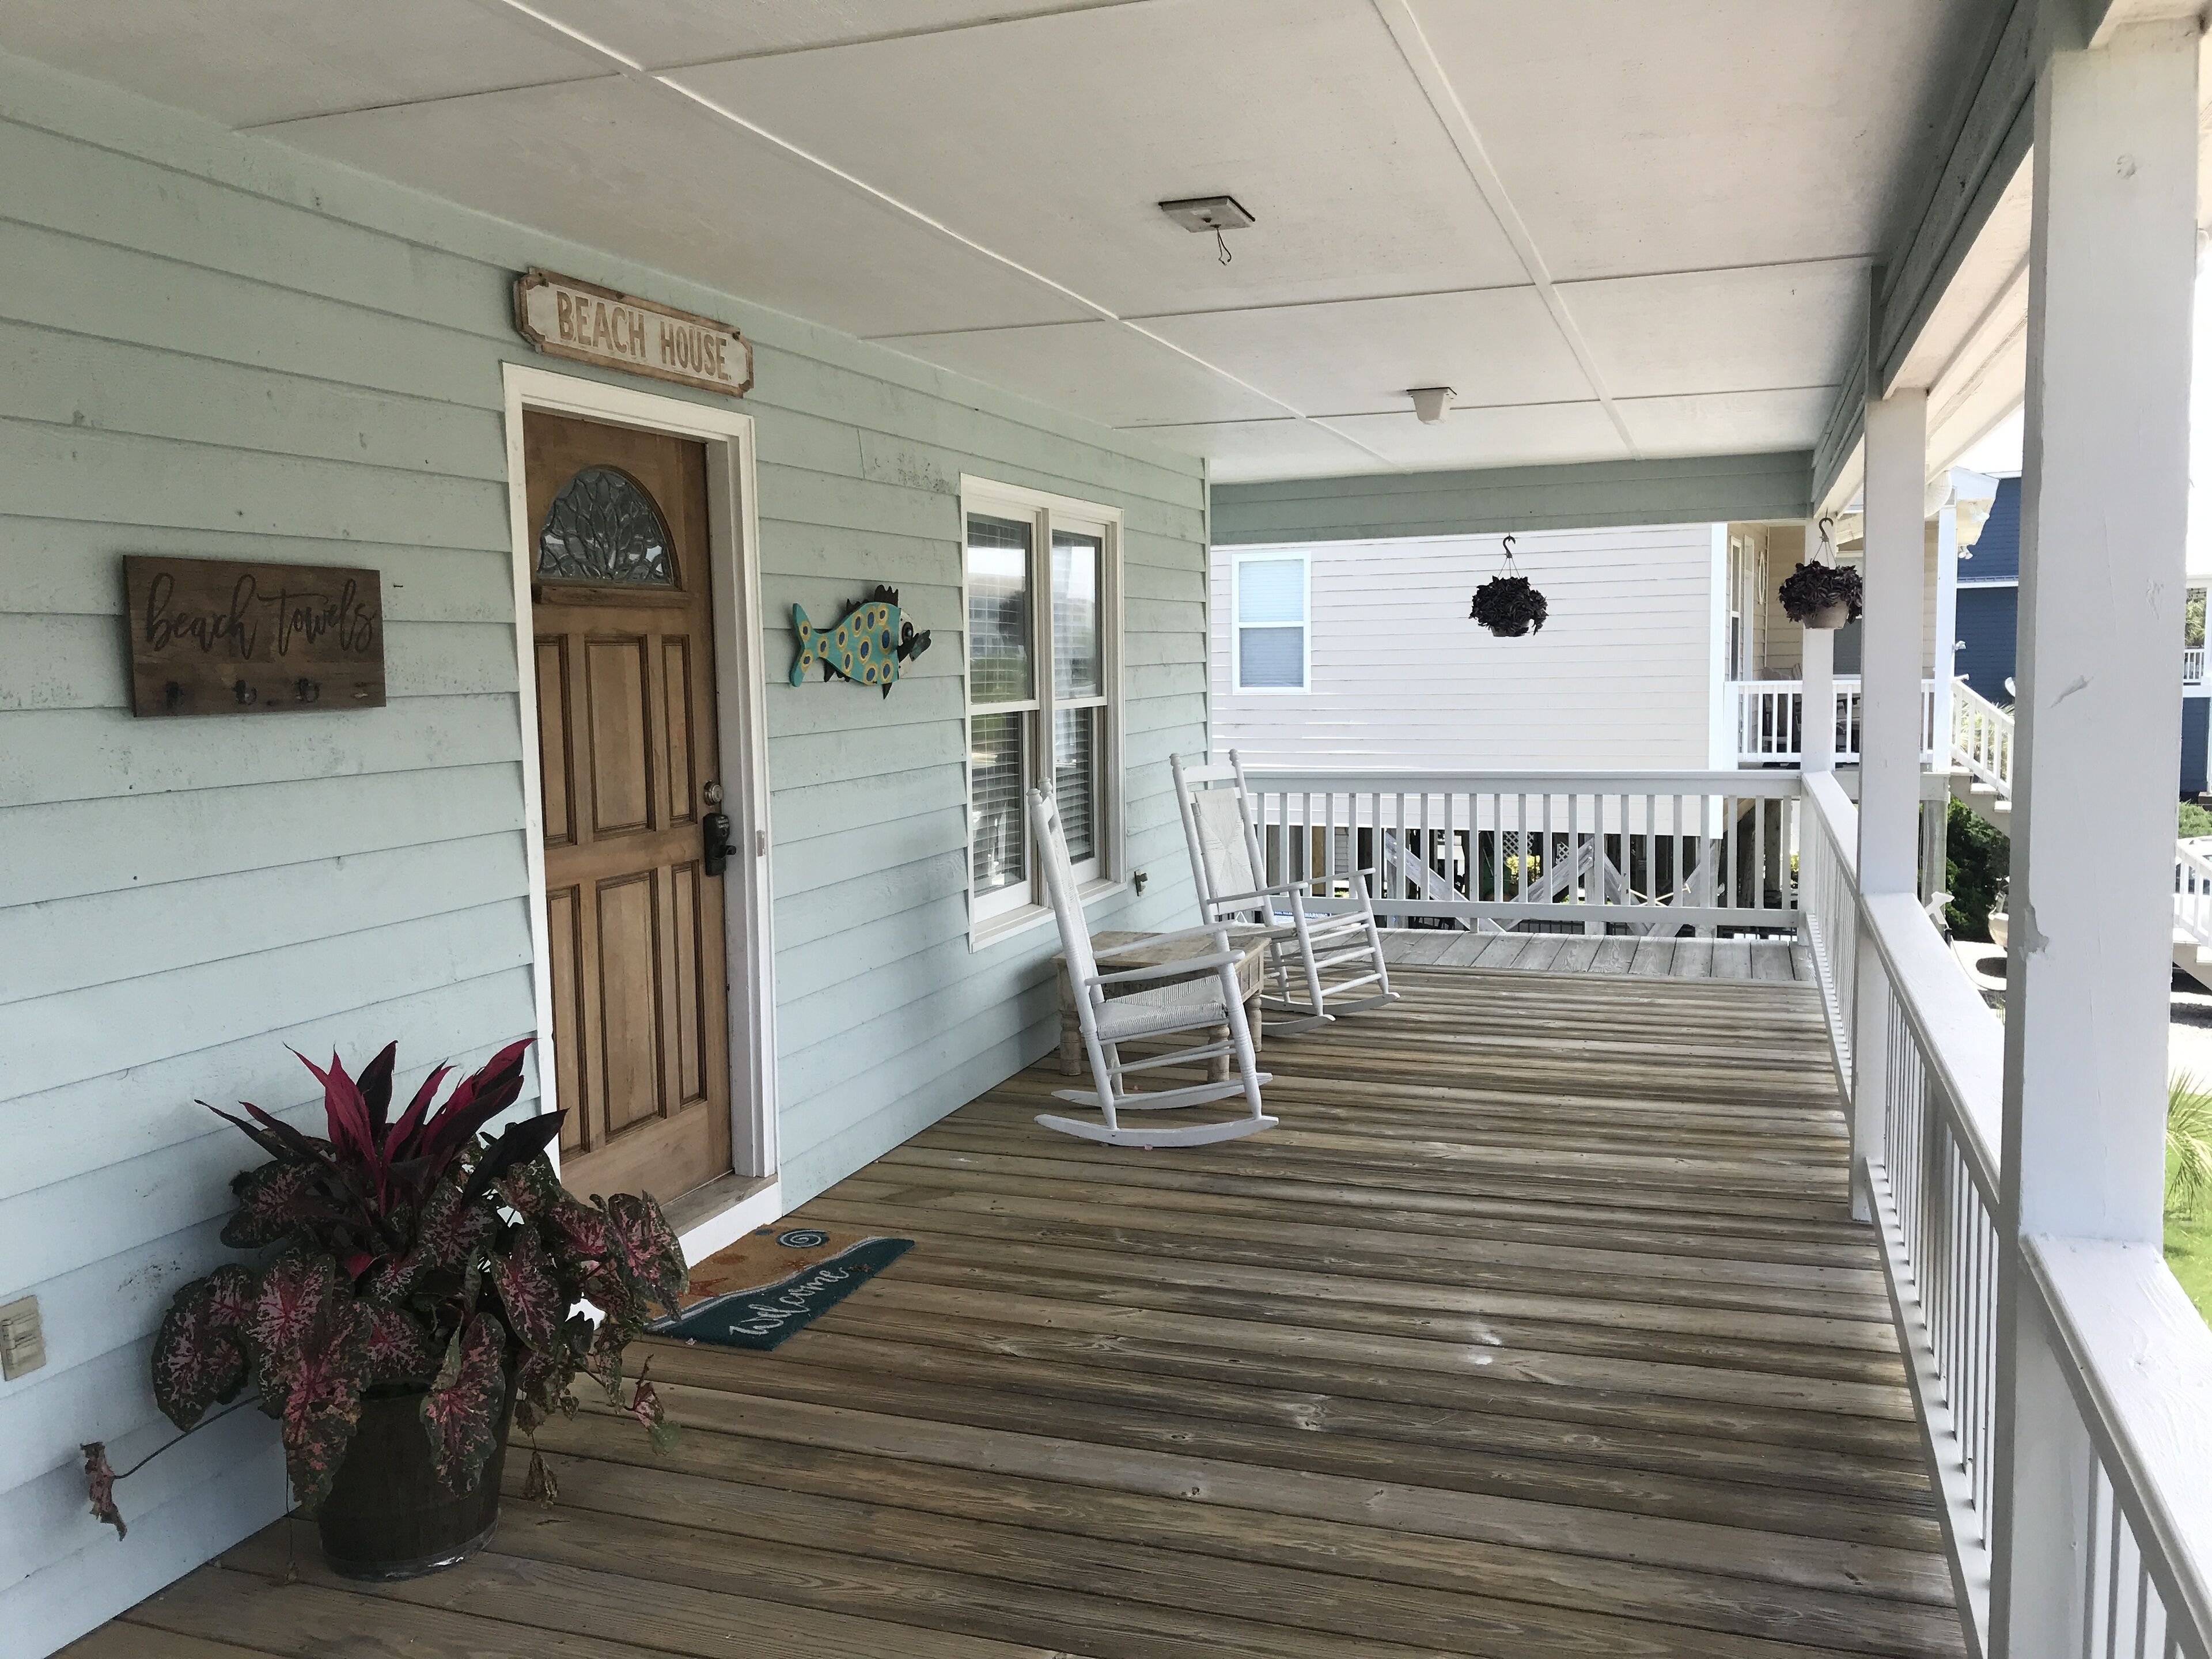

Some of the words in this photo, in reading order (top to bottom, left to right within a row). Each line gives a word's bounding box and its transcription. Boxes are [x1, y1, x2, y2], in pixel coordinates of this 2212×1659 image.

[557, 291, 646, 358] BEACH
[660, 321, 729, 380] HOUSE
[146, 572, 257, 660] beach
[257, 578, 378, 657] towels
